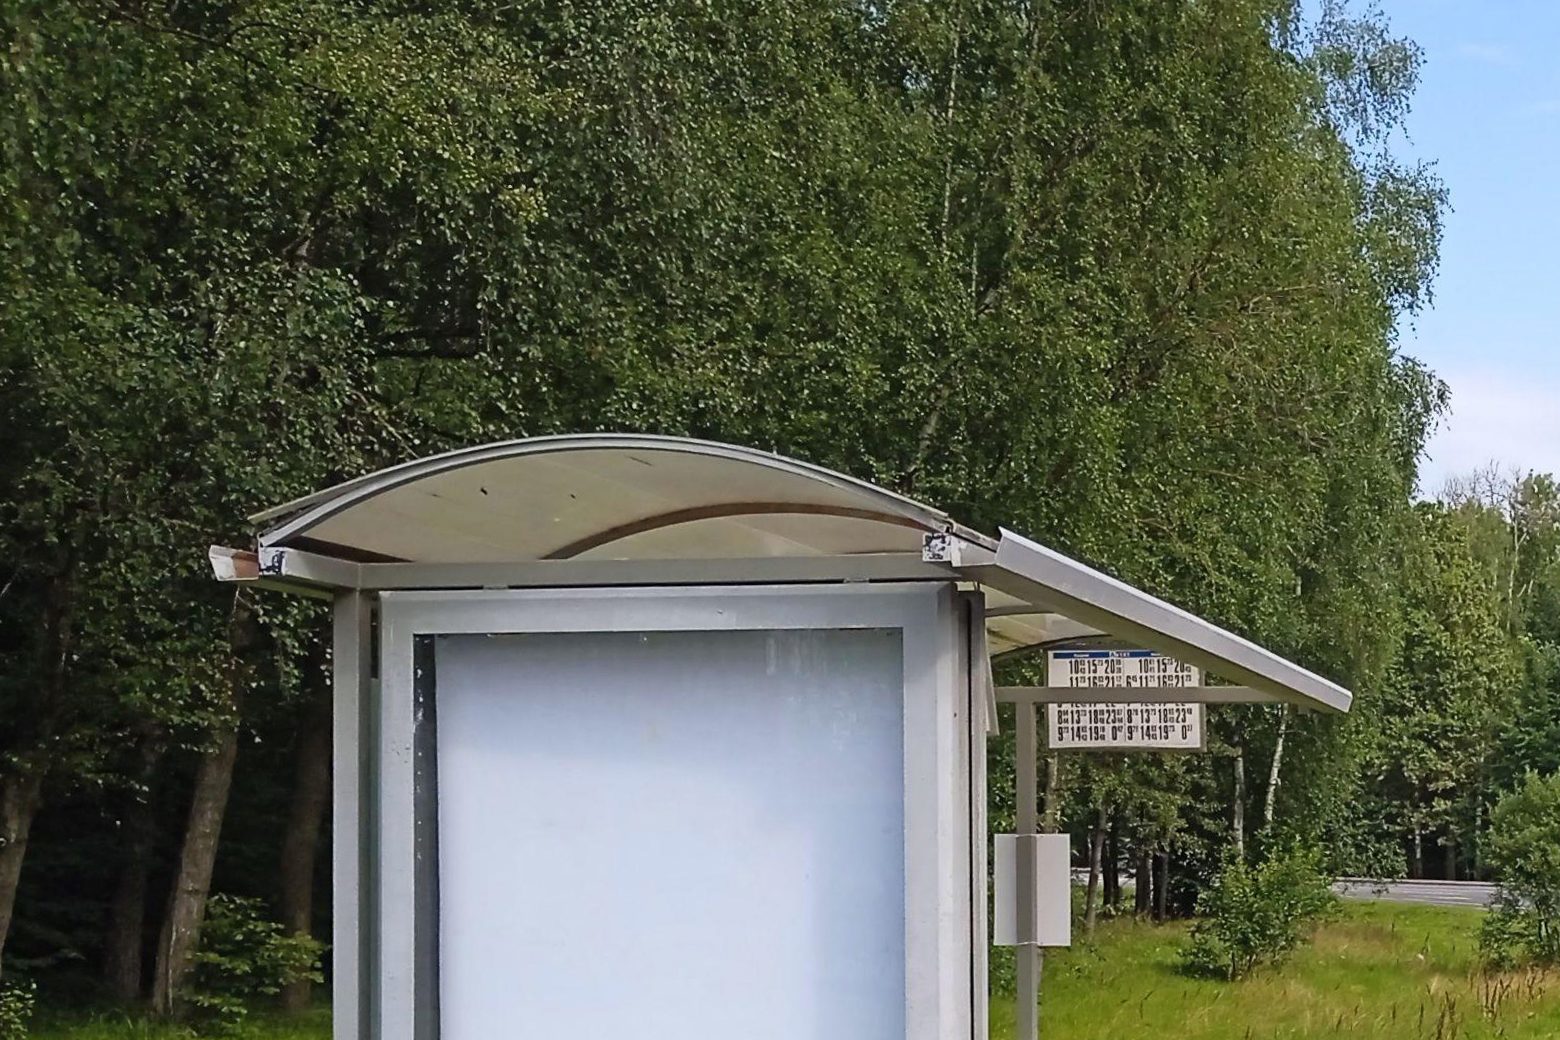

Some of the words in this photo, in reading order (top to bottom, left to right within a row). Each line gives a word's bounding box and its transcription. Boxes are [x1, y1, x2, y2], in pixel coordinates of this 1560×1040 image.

[1069, 660, 1078, 674] 10
[1087, 660, 1097, 674] 15
[1105, 659, 1115, 674] 20
[1139, 659, 1148, 673] 10
[1157, 658, 1167, 673] 15
[1070, 677, 1078, 687] 11
[1087, 676, 1097, 687] 16
[1105, 676, 1115, 687] 21
[1126, 675, 1131, 687] 6
[1139, 675, 1147, 687] 11
[1157, 675, 1167, 687] 16
[1175, 675, 1184, 687] 21
[1057, 709, 1063, 724] 8
[1071, 710, 1080, 724] 13
[1088, 709, 1098, 724] 18
[1106, 709, 1116, 724] 23
[1127, 709, 1132, 723] 8
[1140, 709, 1150, 723] 13
[1158, 708, 1168, 723] 18
[1176, 708, 1186, 723] 23
[1058, 726, 1063, 741] 9
[1071, 726, 1080, 741] 14
[1089, 726, 1099, 741] 19
[1112, 726, 1117, 741] 0
[1127, 726, 1133, 740] 9
[1141, 725, 1150, 740] 14
[1159, 725, 1169, 740] 19
[1182, 725, 1187, 740] 0
